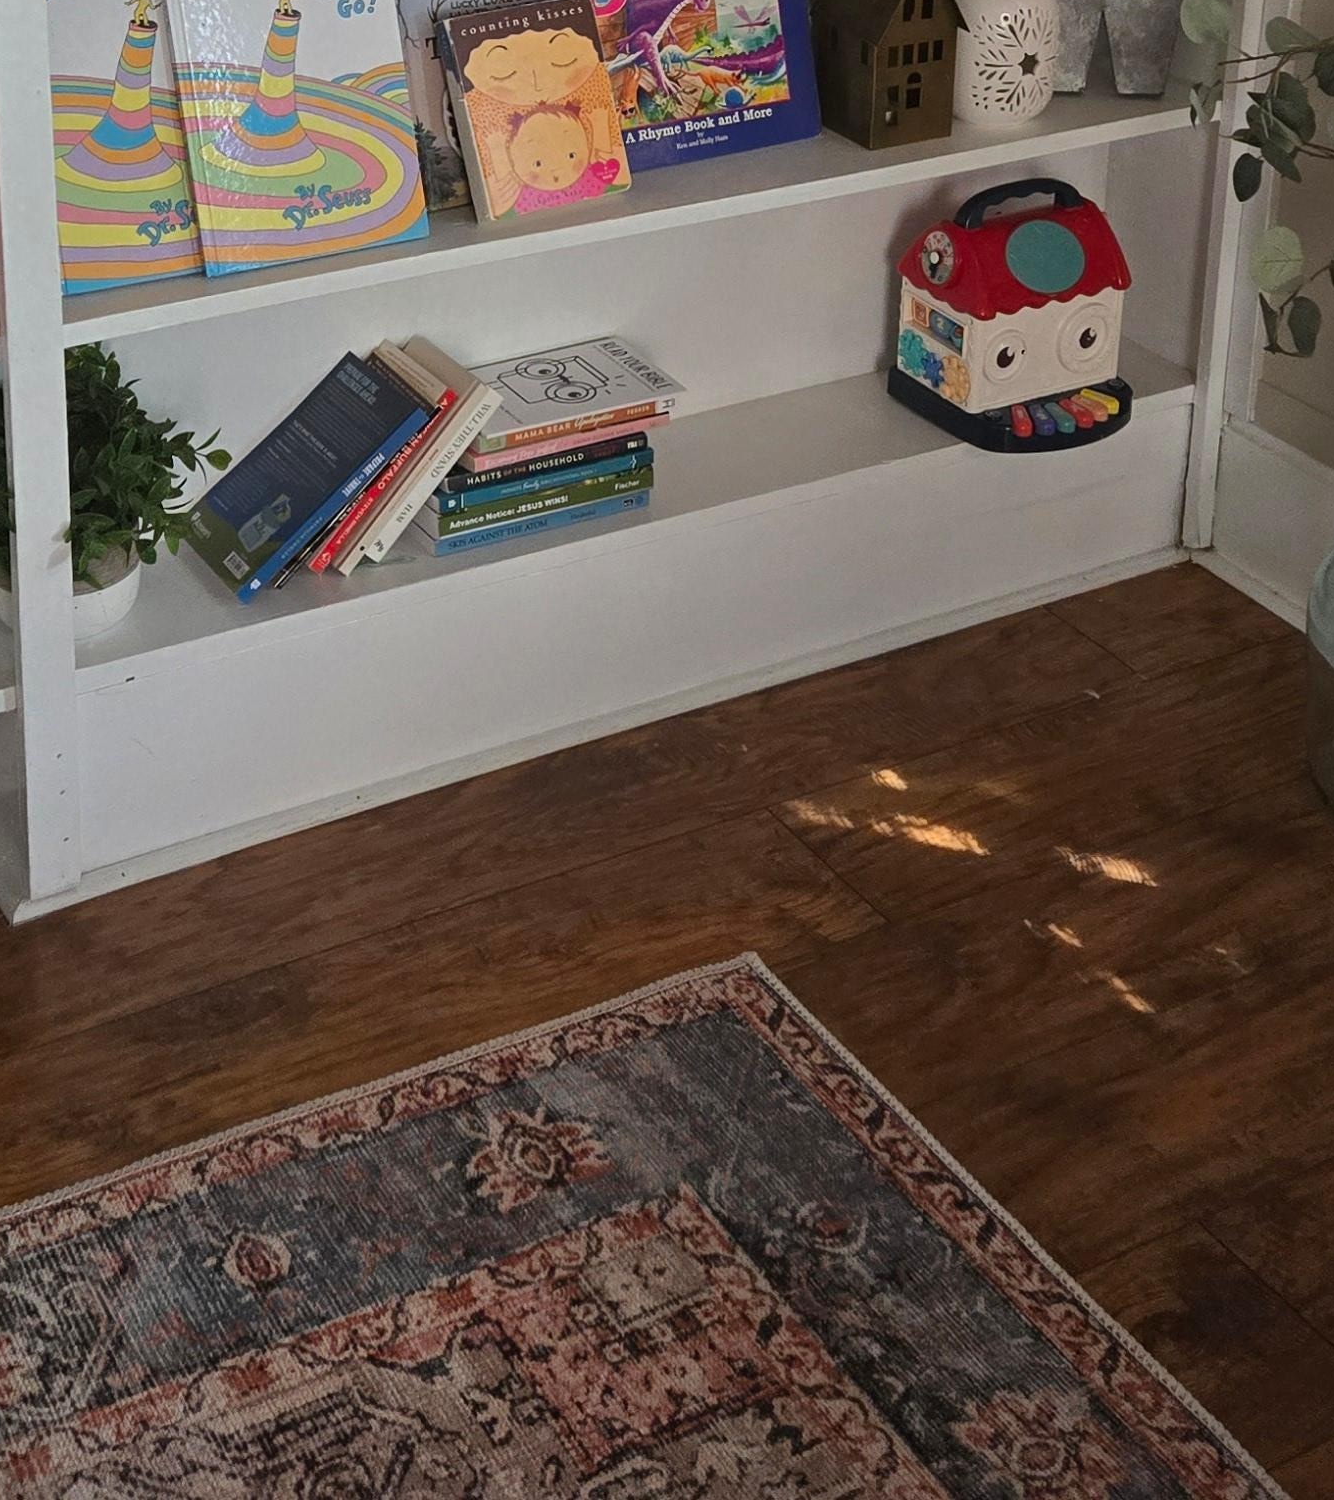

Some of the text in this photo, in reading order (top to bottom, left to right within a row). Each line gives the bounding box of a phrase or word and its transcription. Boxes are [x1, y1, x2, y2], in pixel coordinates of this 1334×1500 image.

[460, 14, 530, 37] counting
[536, 4, 584, 22] kisses
[625, 105, 773, 145] A Rhyme Book and More
[150, 198, 172, 216] By
[294, 183, 316, 200] By
[282, 185, 372, 231] Dr. Seuss
[137, 215, 176, 248] Dr.
[429, 401, 491, 479] WILL THEY STAND
[515, 428, 544, 442] MAMA
[547, 422, 570, 436] BEAR
[376, 446, 413, 491] BUFFALO
[467, 471, 502, 485] HABITS
[529, 453, 585, 472] HOUSEHOLD
[615, 478, 640, 491] Fischer
[354, 496, 374, 519] STEVEN
[395, 503, 414, 525] HAM
[449, 495, 568, 530] Advance Notice: JESUS WINS!
[449, 519, 549, 550] SKIS AGAINST THE ATOM
